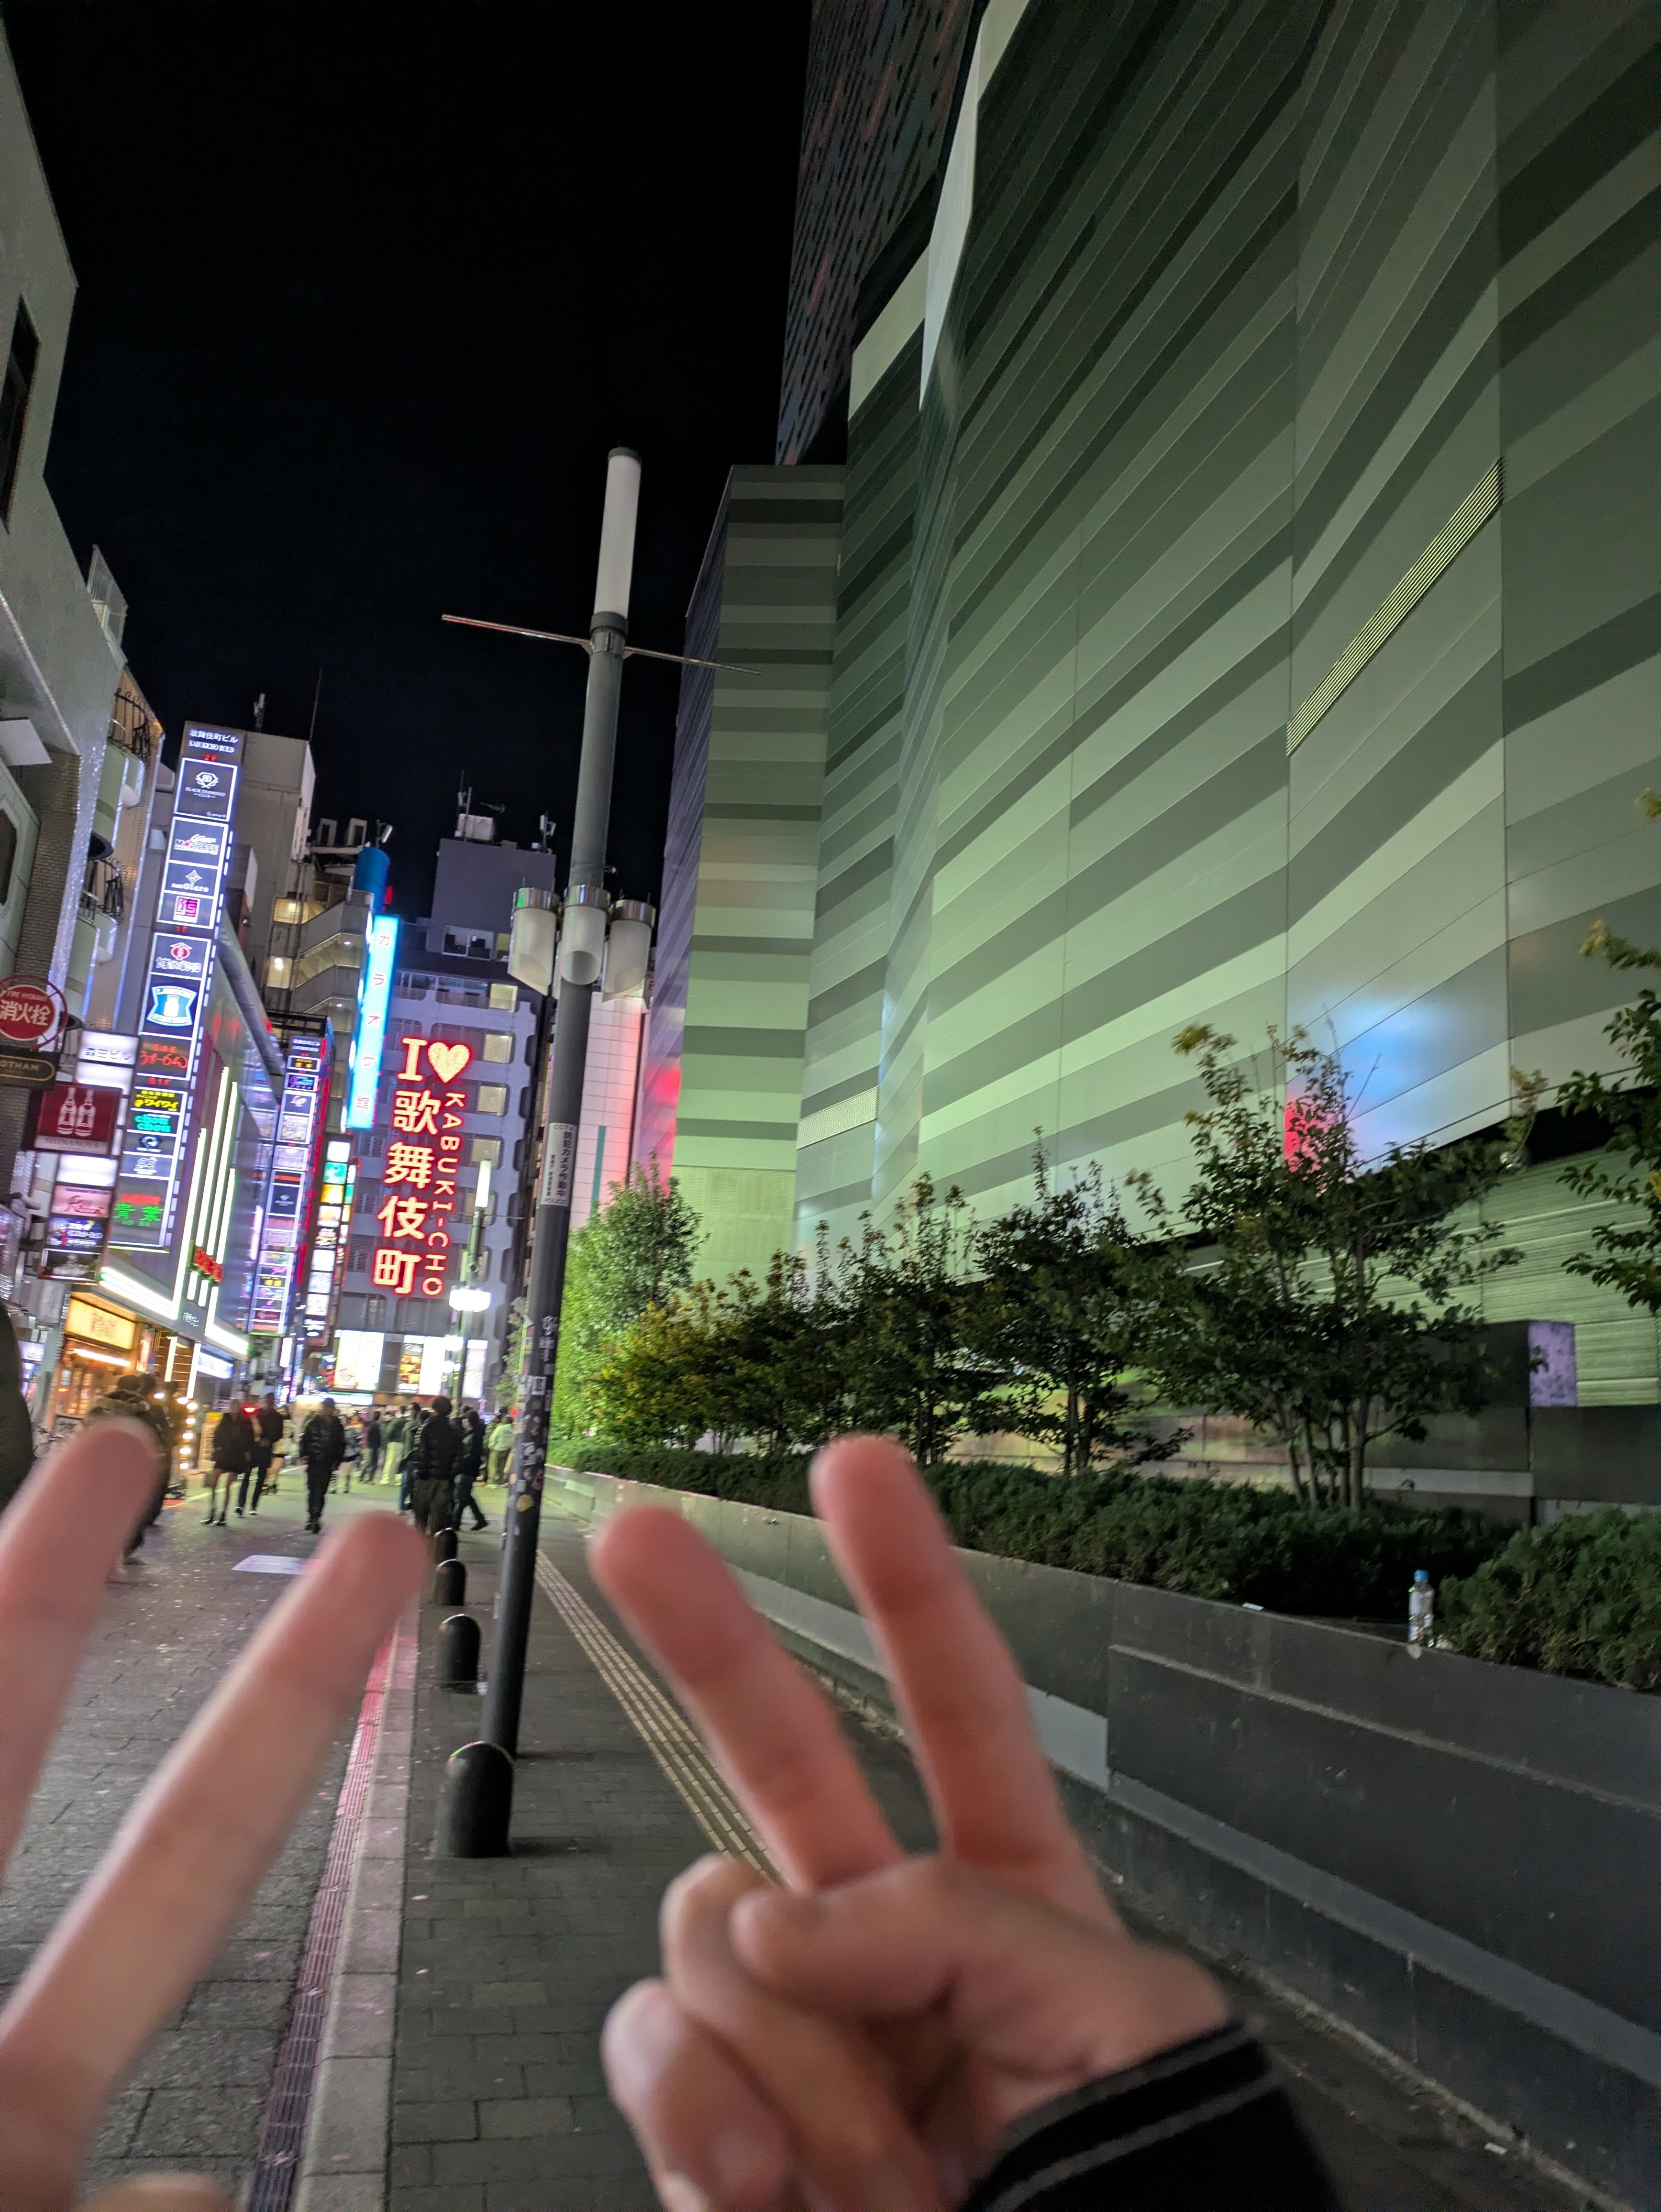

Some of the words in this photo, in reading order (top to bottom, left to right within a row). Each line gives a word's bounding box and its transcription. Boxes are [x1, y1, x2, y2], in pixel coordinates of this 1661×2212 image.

[189, 729, 239, 743] 歌舞伎町ビル
[0, 999, 51, 1025] 消火栓
[356, 935, 390, 1109] カラオケ館
[85, 1048, 131, 1060] 森田ビル
[398, 1038, 428, 1081] I
[372, 1090, 442, 1294] 歌舞伎町
[422, 1092, 465, 1295] KABUKI-CHO
